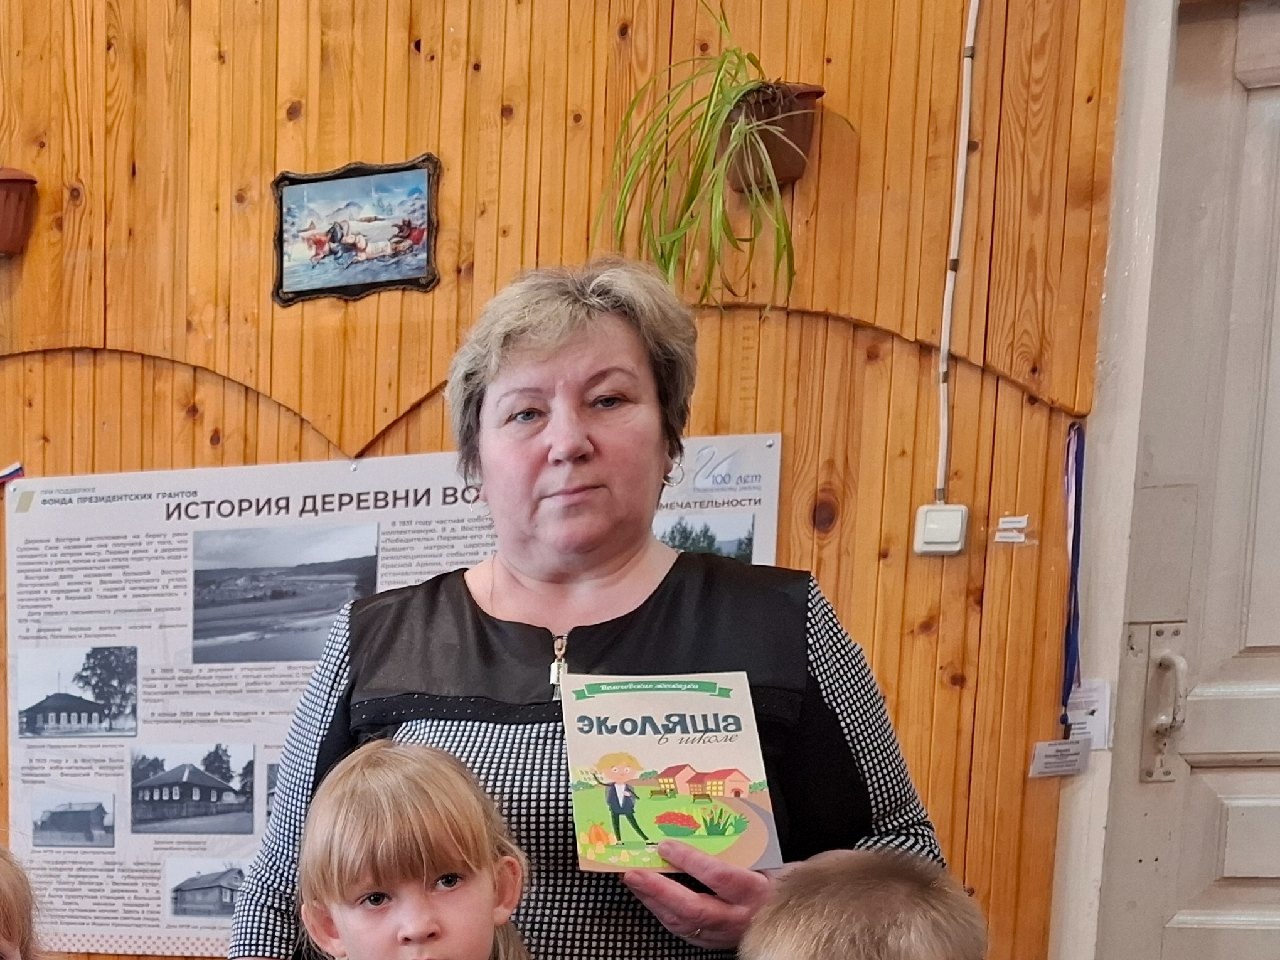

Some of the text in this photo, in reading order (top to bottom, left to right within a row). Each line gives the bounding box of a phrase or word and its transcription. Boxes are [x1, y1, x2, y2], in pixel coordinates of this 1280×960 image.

[76, 493, 153, 504] ПРЕЗИДЕНТСКИХ
[156, 490, 198, 500] ГРАНТОВ
[165, 496, 290, 521] ИСТОРИЯ
[298, 487, 431, 517] ДЕРЕВНИ
[678, 729, 739, 745] школе
